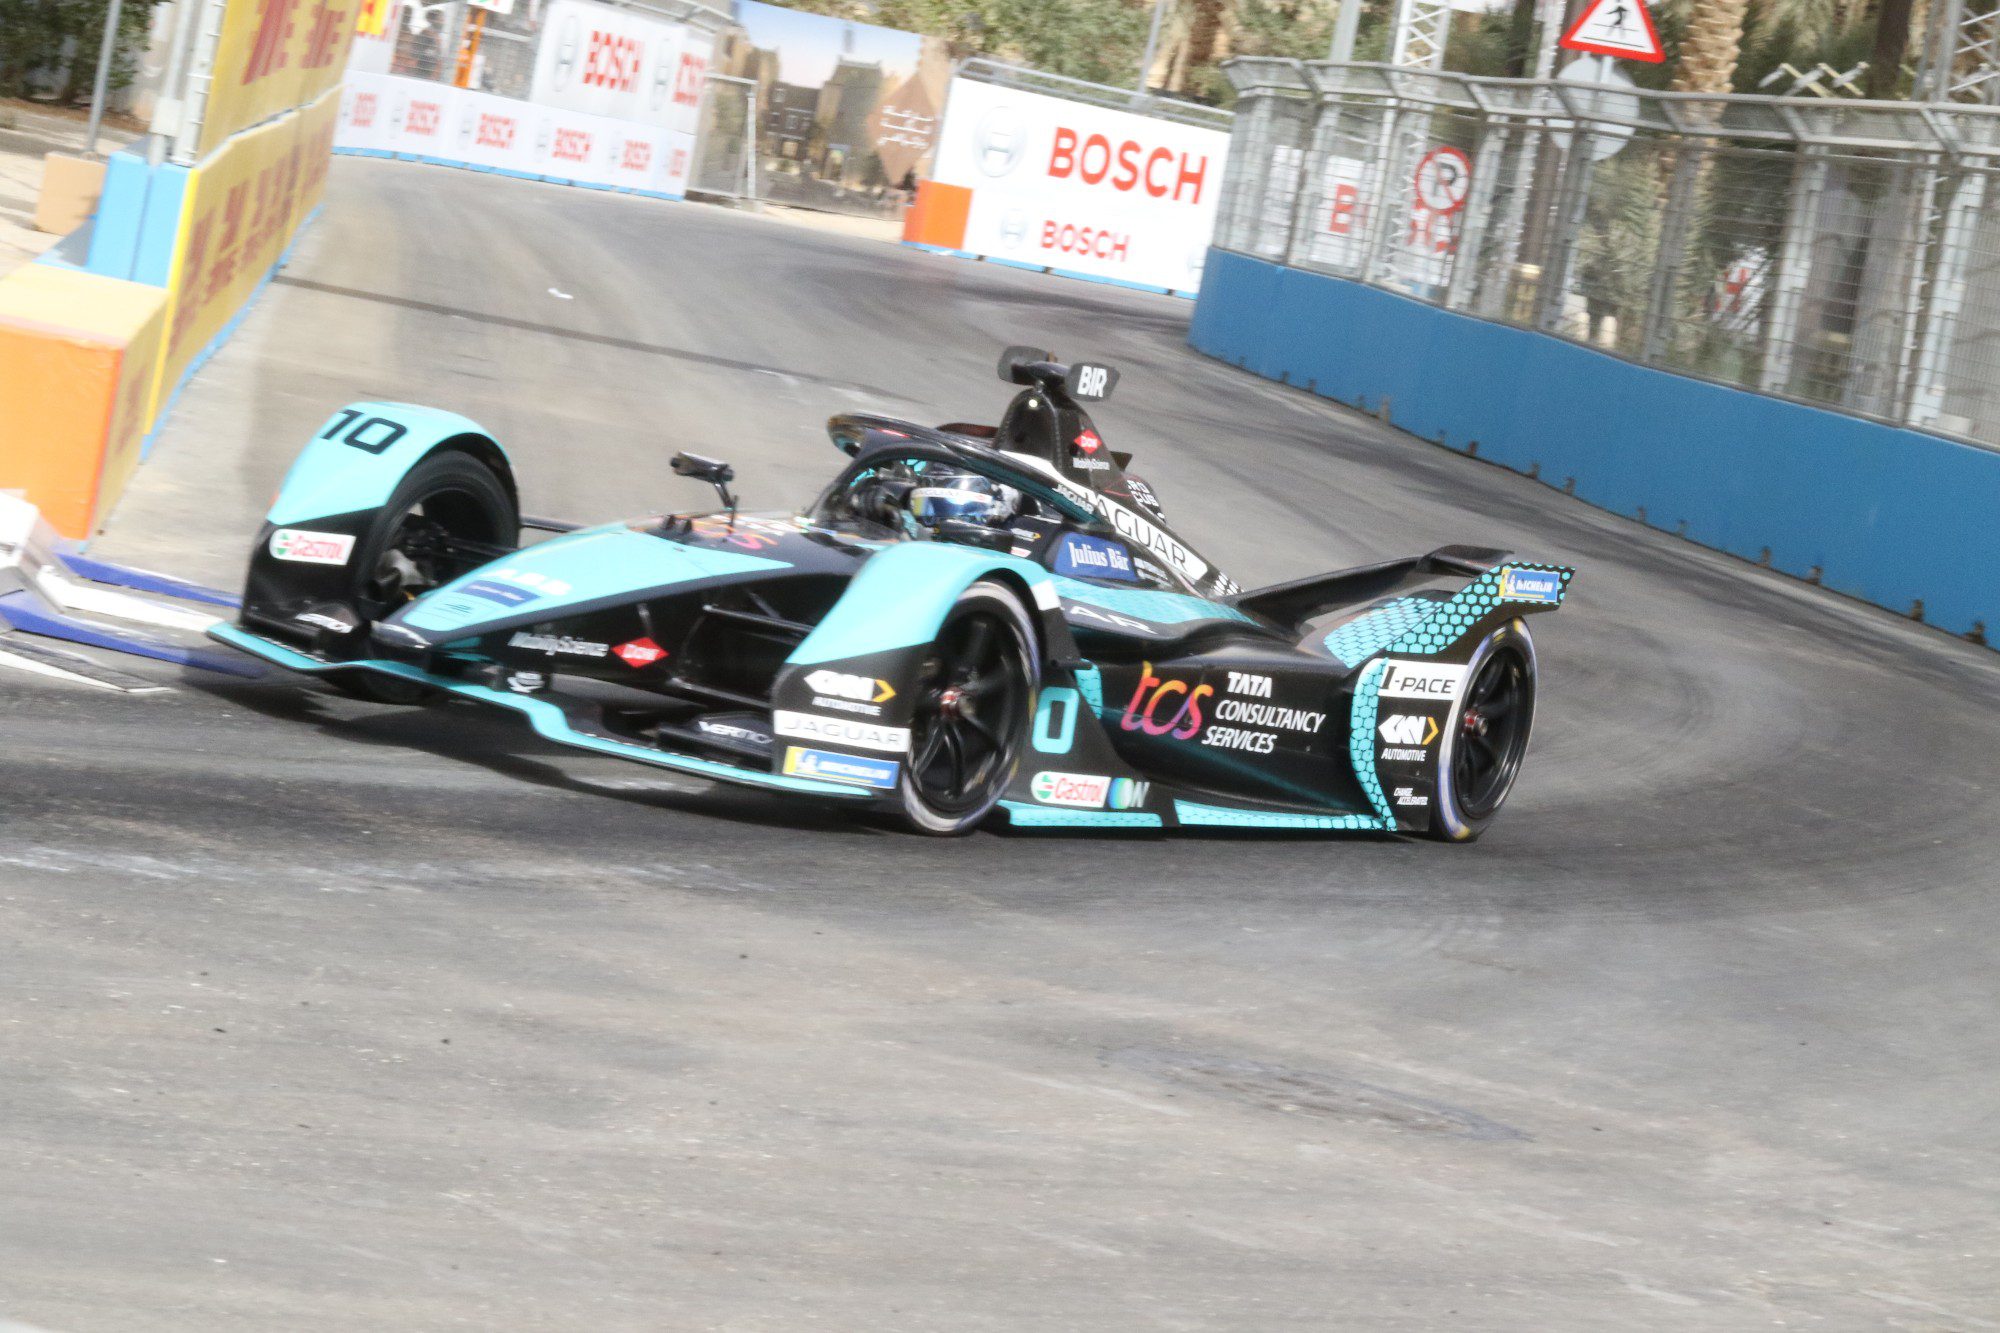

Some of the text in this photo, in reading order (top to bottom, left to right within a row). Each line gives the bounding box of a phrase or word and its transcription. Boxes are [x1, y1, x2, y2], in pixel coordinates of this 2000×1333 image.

[1047, 126, 1208, 205] BOSCH
[1040, 219, 1131, 262] BOSCH
[1077, 365, 1108, 397] BIR
[320, 409, 408, 455] 10
[1068, 542, 1130, 571] Julius Bär
[1516, 579, 1553, 593] MICHELIN
[1227, 671, 1273, 698] TATA
[1379, 666, 1457, 694] I-PACE
[1120, 660, 1214, 740] tcs
[1215, 699, 1327, 734] CONSULTANCY
[784, 720, 902, 746] JAGUAR
[1201, 726, 1278, 754] SERVICES
[1380, 747, 1427, 762] AUTOMOTIVE
[1053, 776, 1103, 803] Castrol
